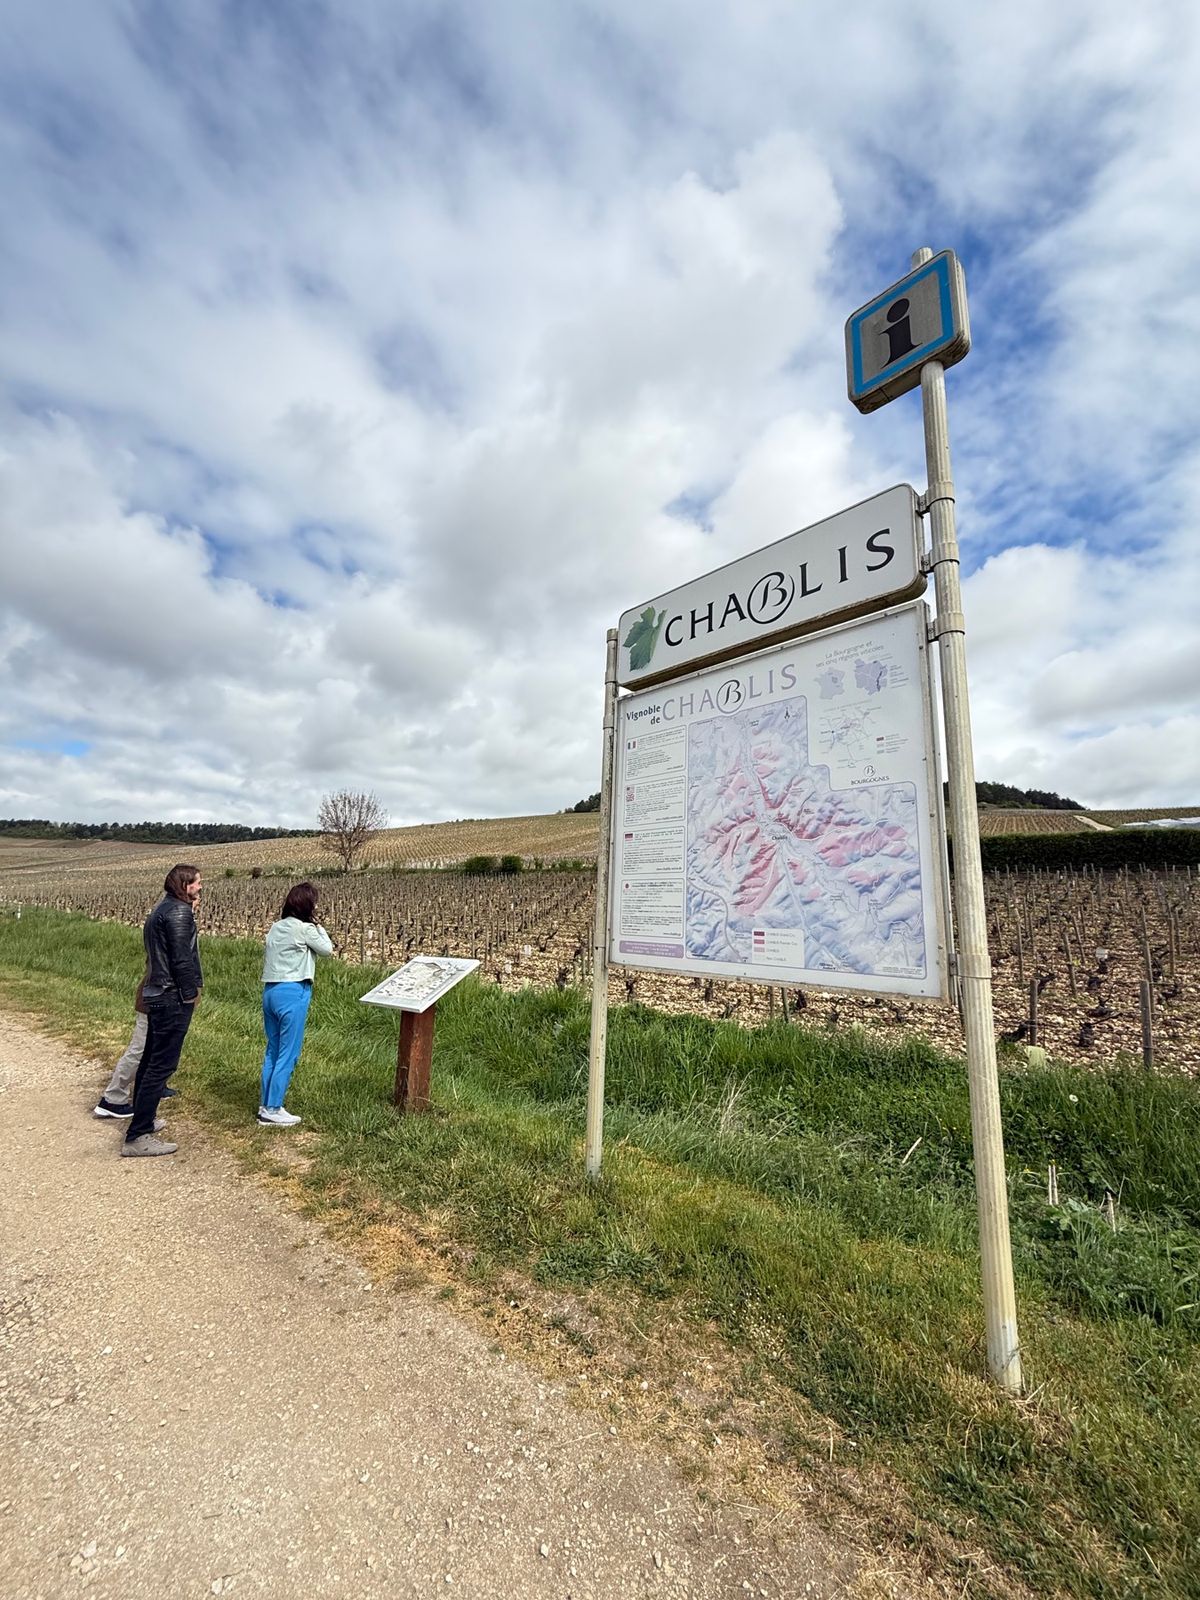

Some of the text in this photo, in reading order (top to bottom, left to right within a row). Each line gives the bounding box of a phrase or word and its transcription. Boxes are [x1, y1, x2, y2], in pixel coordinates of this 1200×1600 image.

[878, 298, 923, 369] i
[664, 528, 895, 647] CHABLIS
[626, 704, 661, 721] Vignoble
[650, 715, 661, 725] de
[662, 663, 797, 721] CHABLIS
